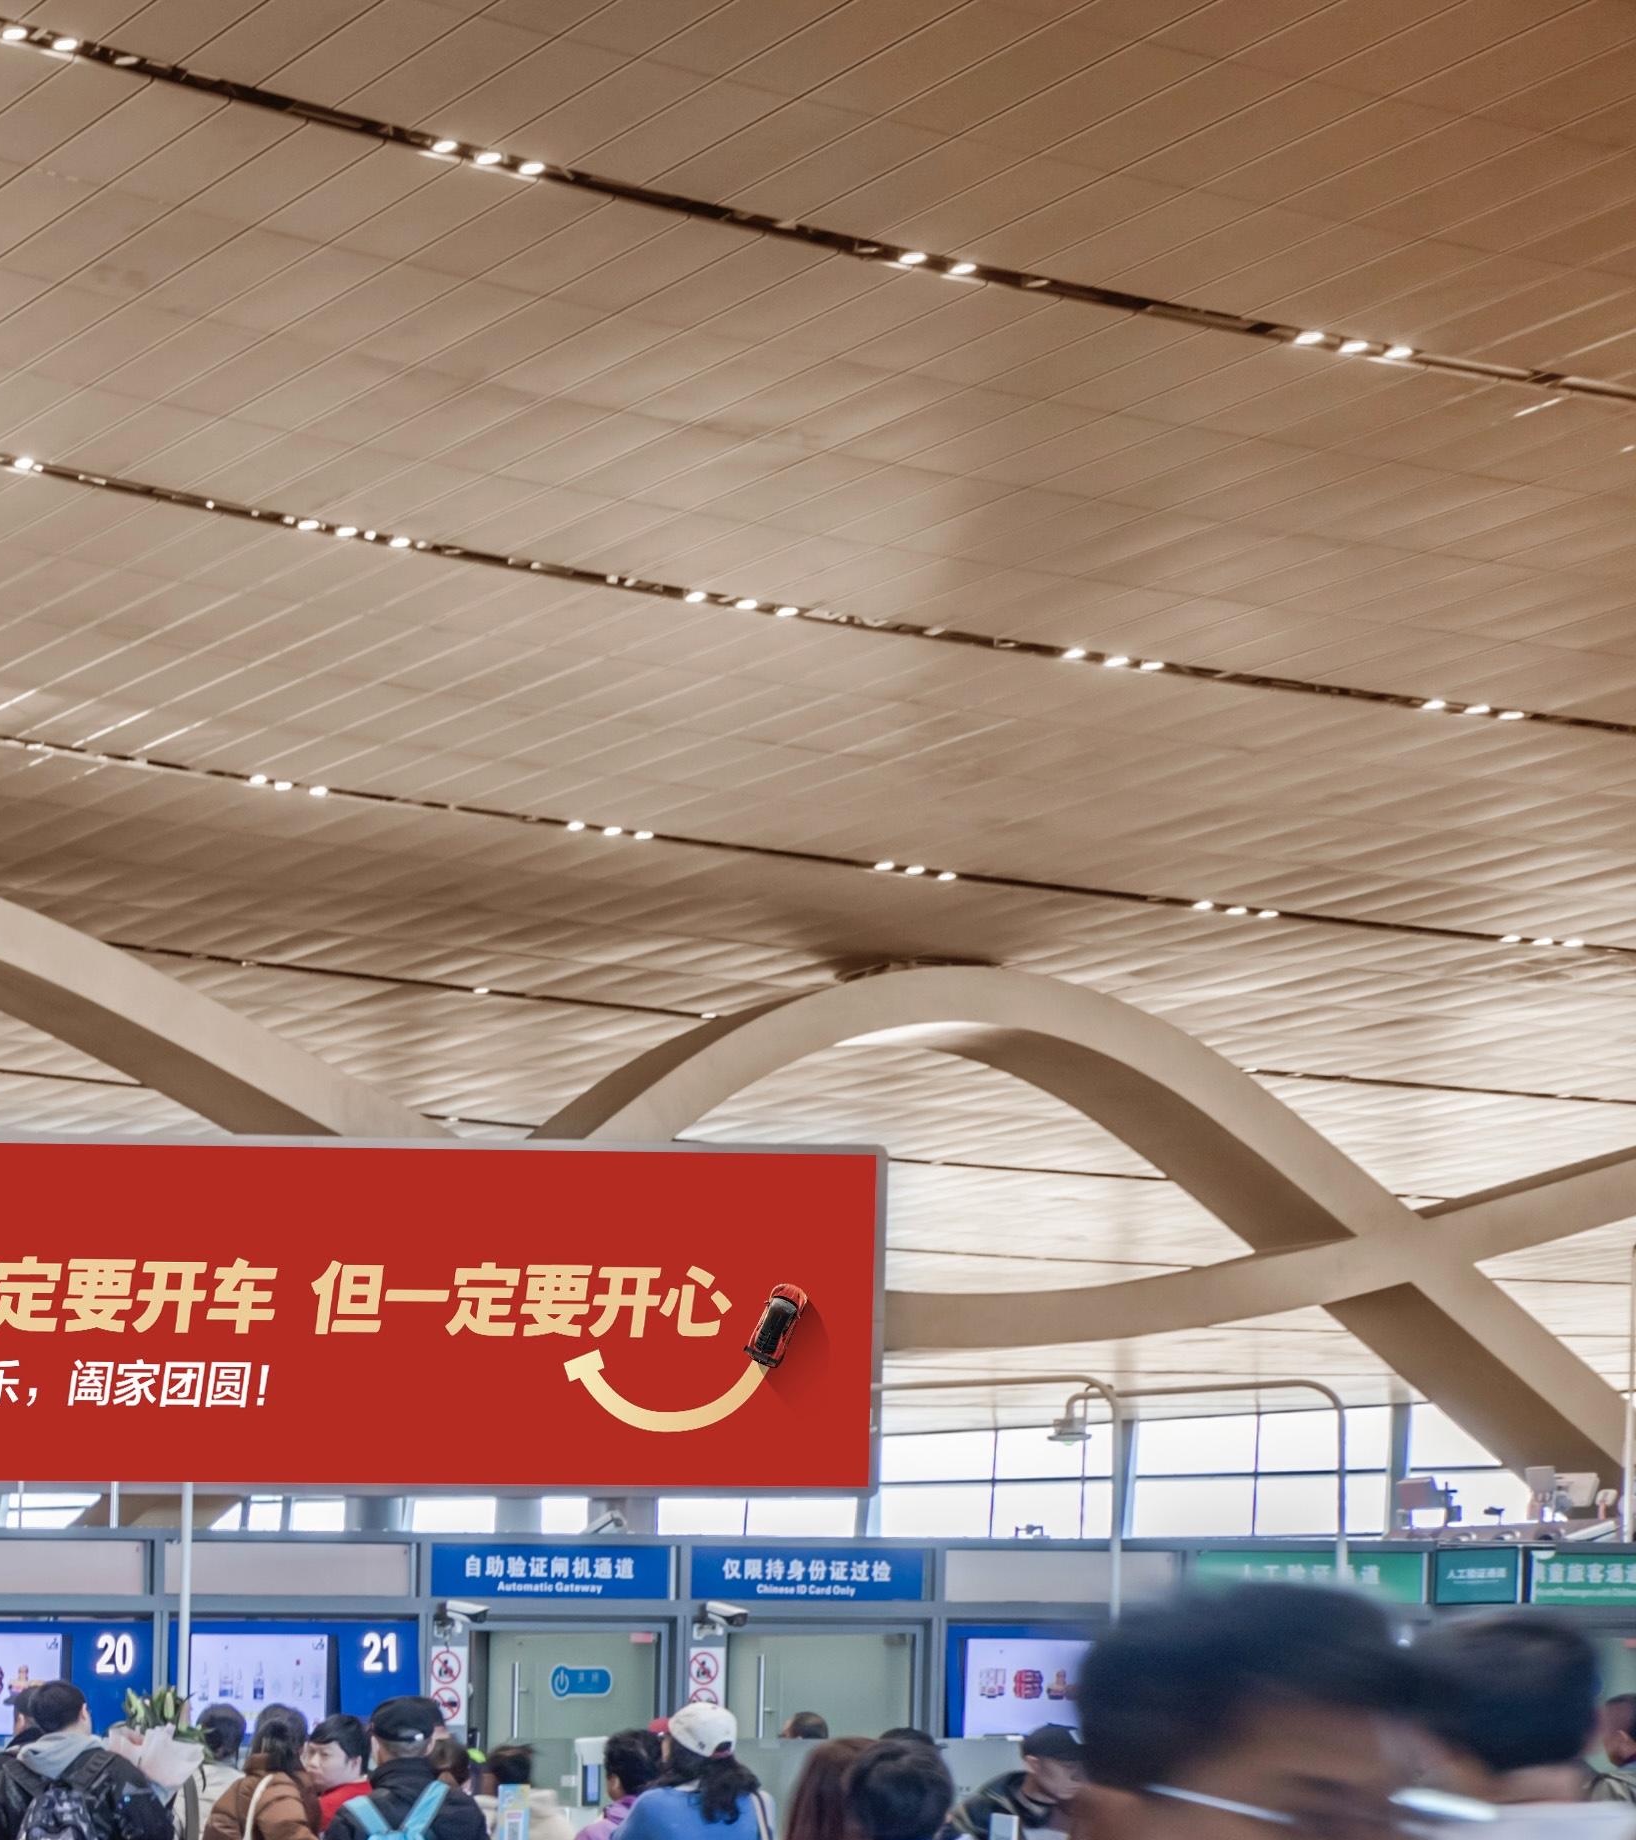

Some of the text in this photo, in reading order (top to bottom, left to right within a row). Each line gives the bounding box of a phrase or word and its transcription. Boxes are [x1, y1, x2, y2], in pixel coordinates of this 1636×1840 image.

[312, 1260, 733, 1341] 但一定要开心
[465, 1555, 634, 1579] 自助验证闸机通道
[723, 1558, 891, 1581] 仅限持身份证过检
[497, 1581, 603, 1597] Automatic Gateway
[756, 1583, 856, 1599] Chinese ID Card Only
[96, 1634, 134, 1674] 20
[362, 1633, 398, 1673] 21
